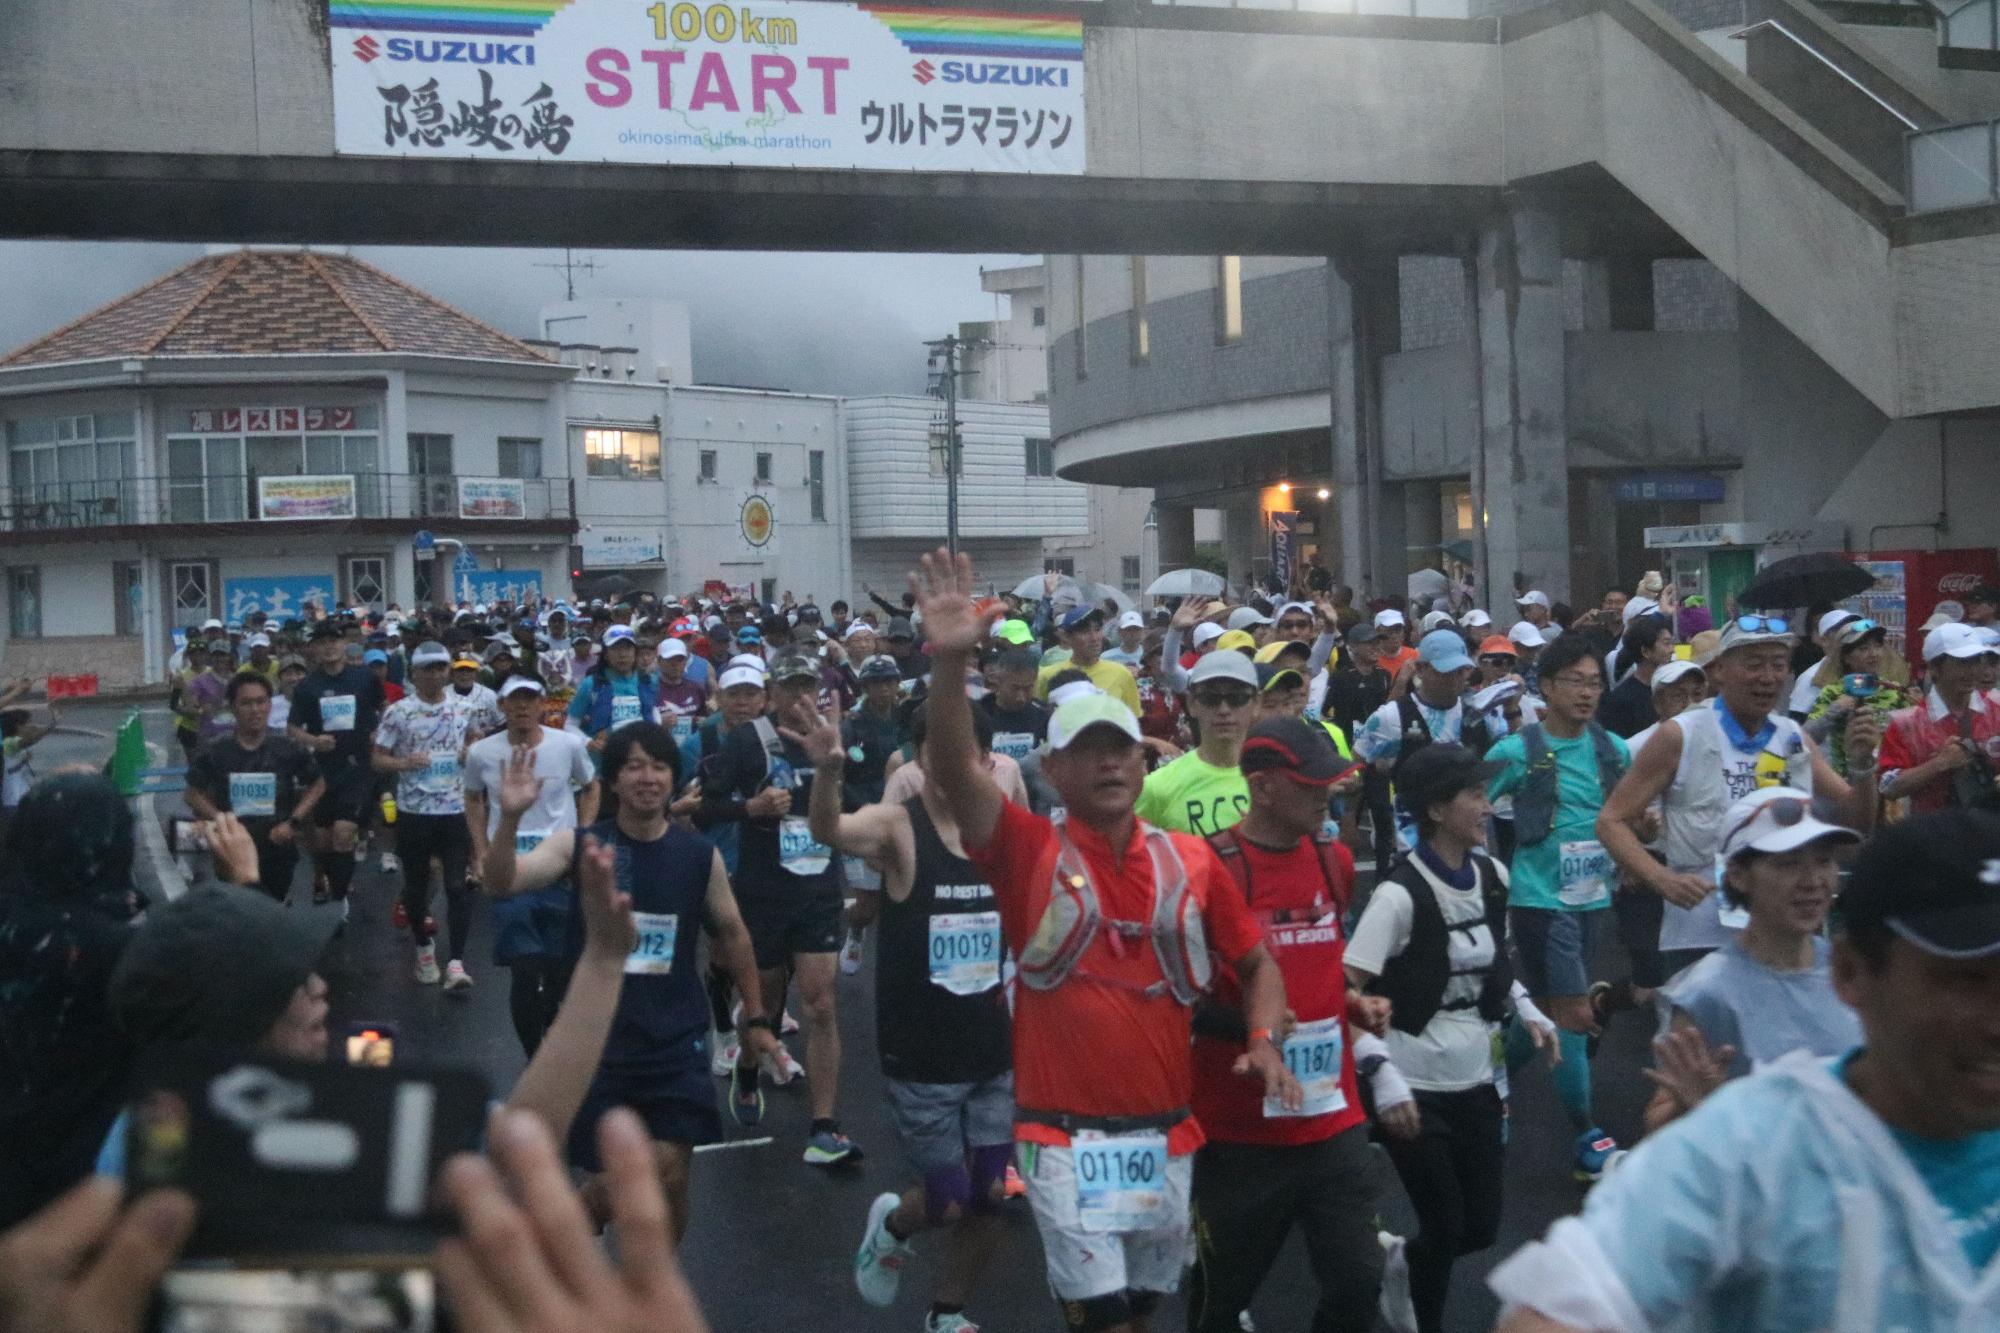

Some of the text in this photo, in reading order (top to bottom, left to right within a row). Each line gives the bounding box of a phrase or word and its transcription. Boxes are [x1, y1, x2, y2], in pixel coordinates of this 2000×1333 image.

[646, 2, 798, 45] 100km
[386, 38, 536, 67] SUZUKI
[585, 47, 850, 115] START
[941, 61, 1069, 88] SUZUKI
[376, 68, 574, 156] 隠岐の島
[860, 100, 1072, 150] ウルトラマラソン
[618, 129, 832, 150] okinosima ultra marathon
[932, 931, 993, 960] 01019
[1286, 1041, 1335, 1075] 1187
[1080, 1150, 1155, 1183] 01160
